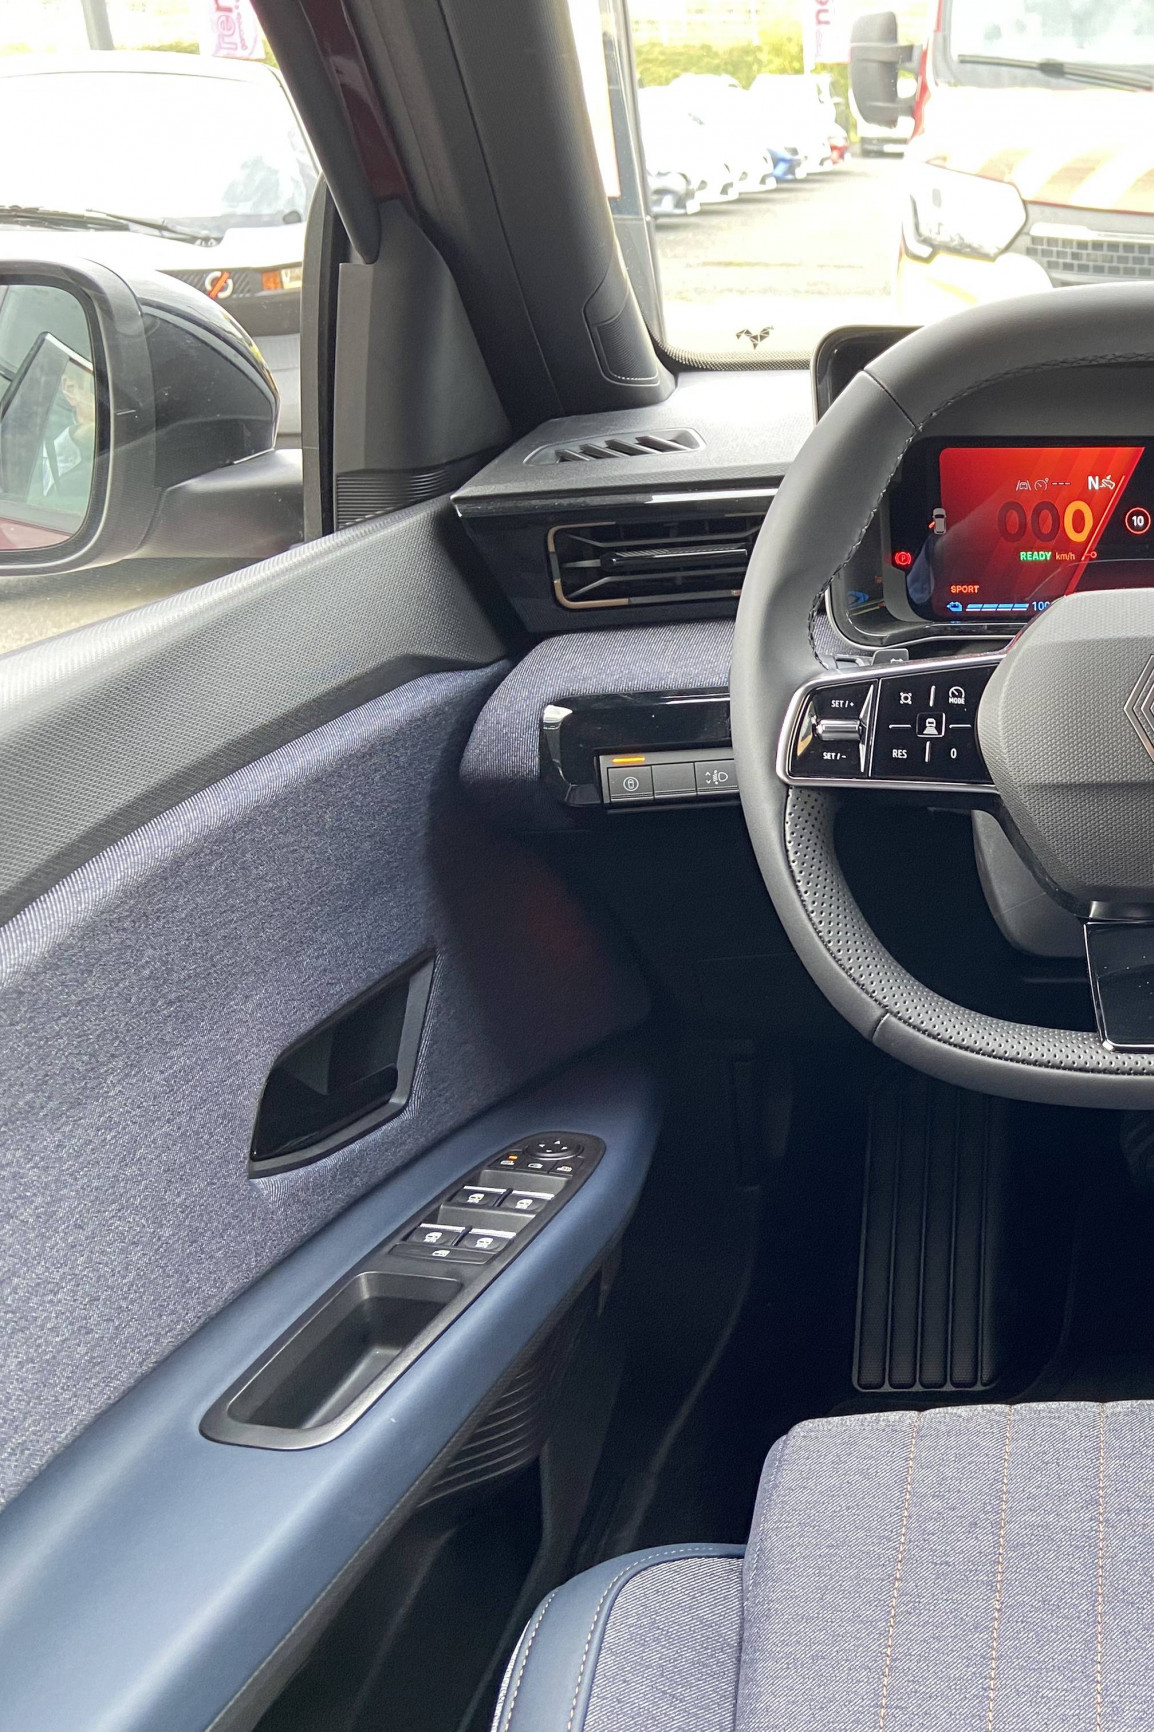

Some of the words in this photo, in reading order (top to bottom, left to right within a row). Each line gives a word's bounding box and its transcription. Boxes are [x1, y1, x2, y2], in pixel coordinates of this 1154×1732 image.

[1087, 475, 1100, 490] N
[1131, 515, 1145, 527] 10
[1019, 551, 1052, 561] READY
[1055, 551, 1076, 560] km/h
[950, 585, 980, 593] SPORT
[831, 700, 845, 708] SET
[949, 697, 965, 705] MODE
[823, 752, 836, 760] SET
[892, 749, 907, 759] RES
